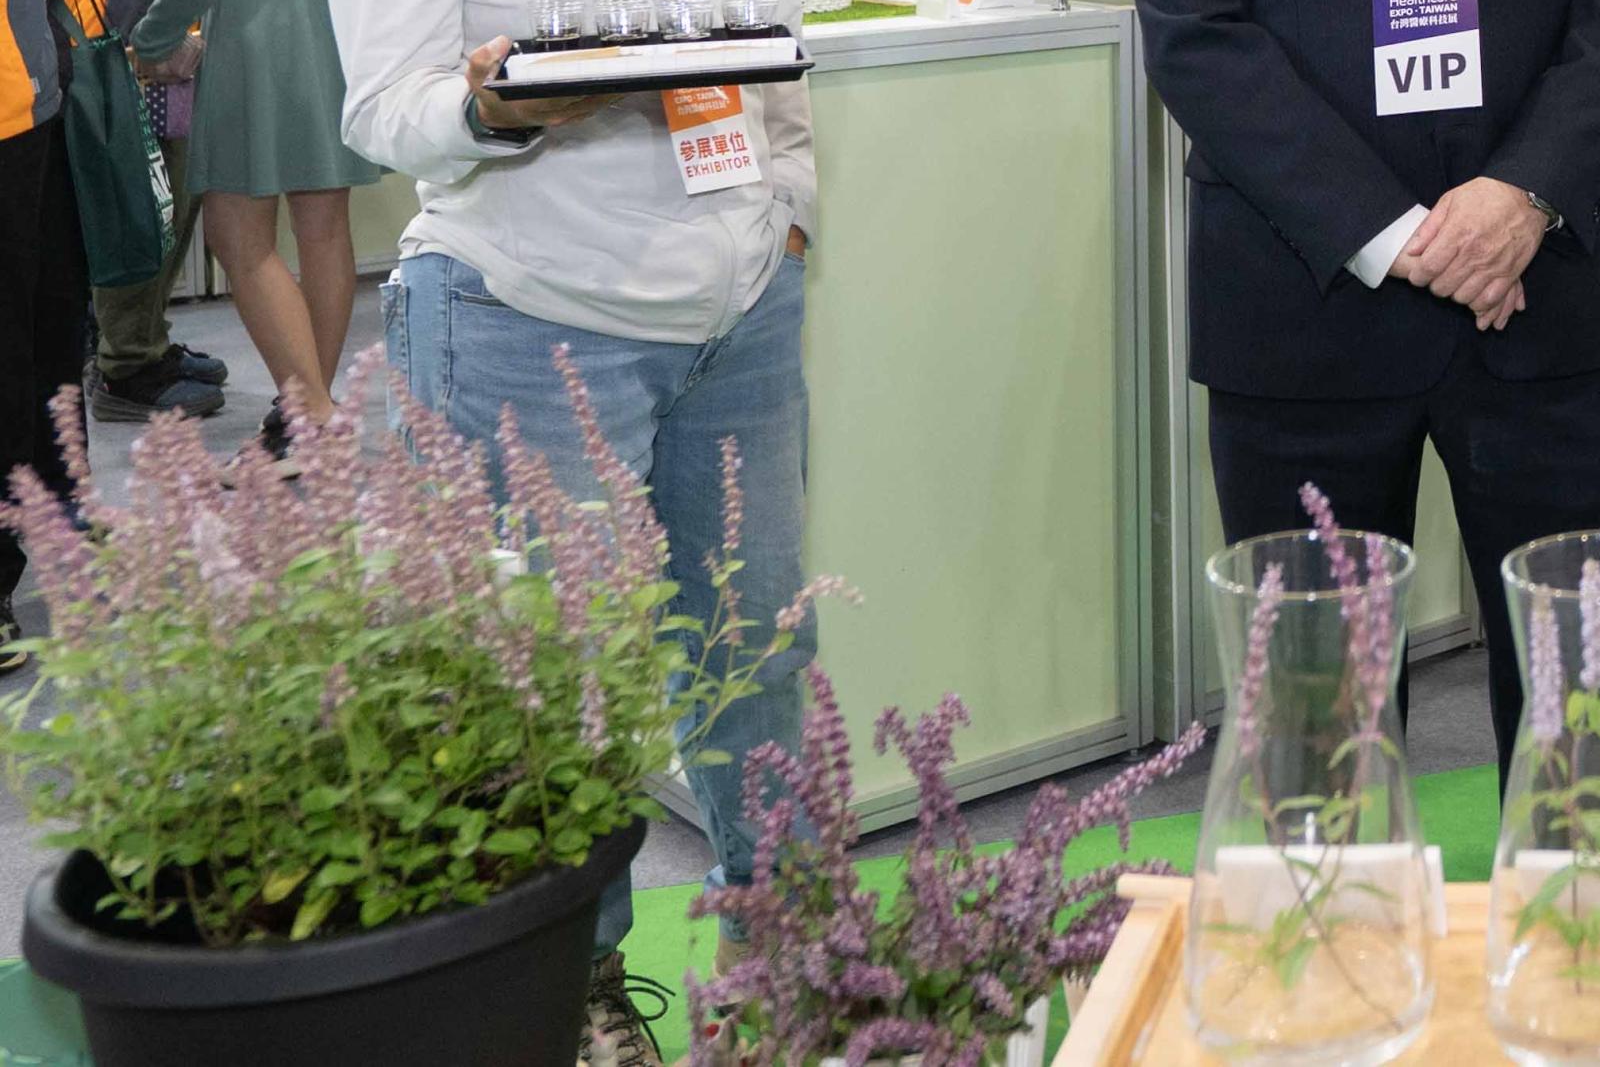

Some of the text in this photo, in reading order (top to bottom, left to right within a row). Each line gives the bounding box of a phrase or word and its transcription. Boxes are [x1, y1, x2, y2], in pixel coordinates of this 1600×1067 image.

[1389, 3, 1458, 18] EXPO TAIWAN
[1387, 52, 1467, 94] VIP
[680, 130, 749, 162] 參展單位
[685, 155, 752, 178] EXHIBITOR
